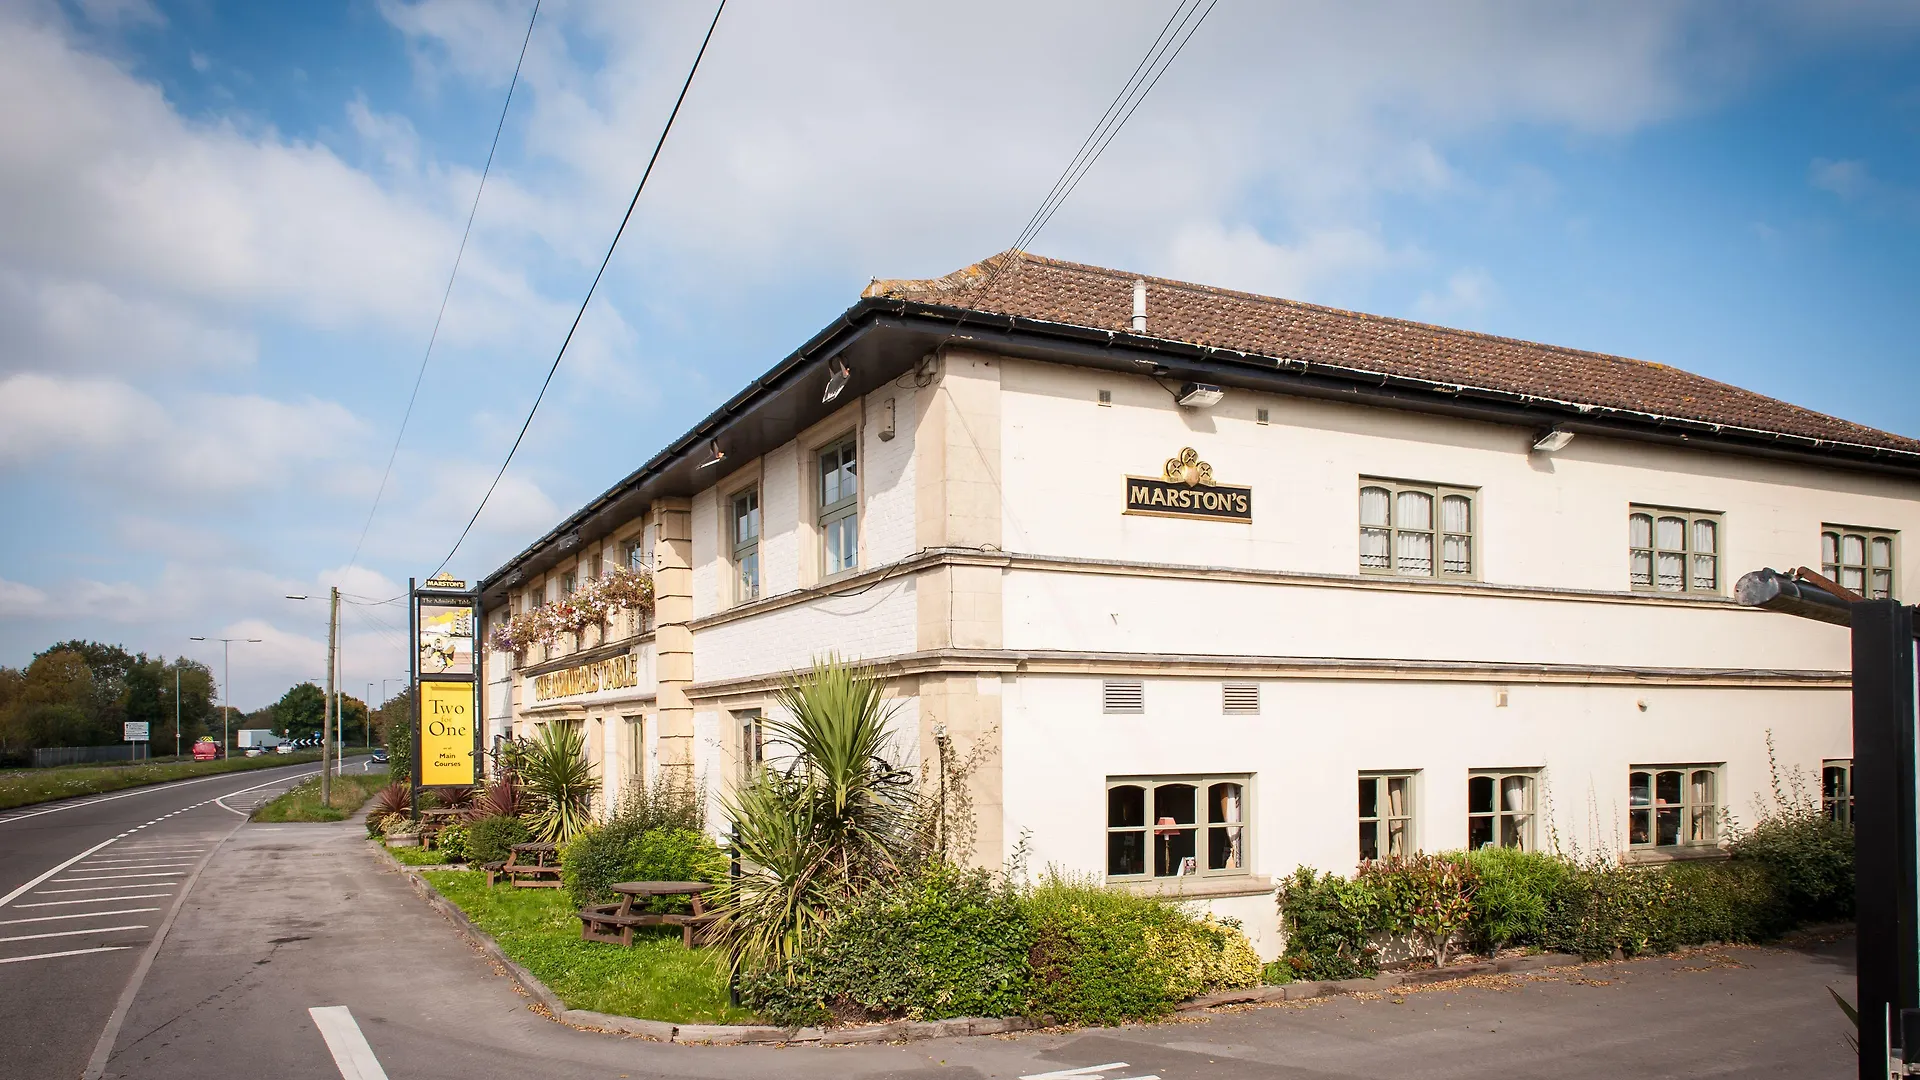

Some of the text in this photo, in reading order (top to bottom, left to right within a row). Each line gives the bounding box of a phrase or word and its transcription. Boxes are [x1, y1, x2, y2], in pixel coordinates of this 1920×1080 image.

[1130, 485, 1247, 513] MARSTON'S
[427, 580, 465, 588] MARSTON'S
[599, 653, 637, 690] TABLE
[428, 699, 465, 714] Two
[429, 720, 466, 736] One
